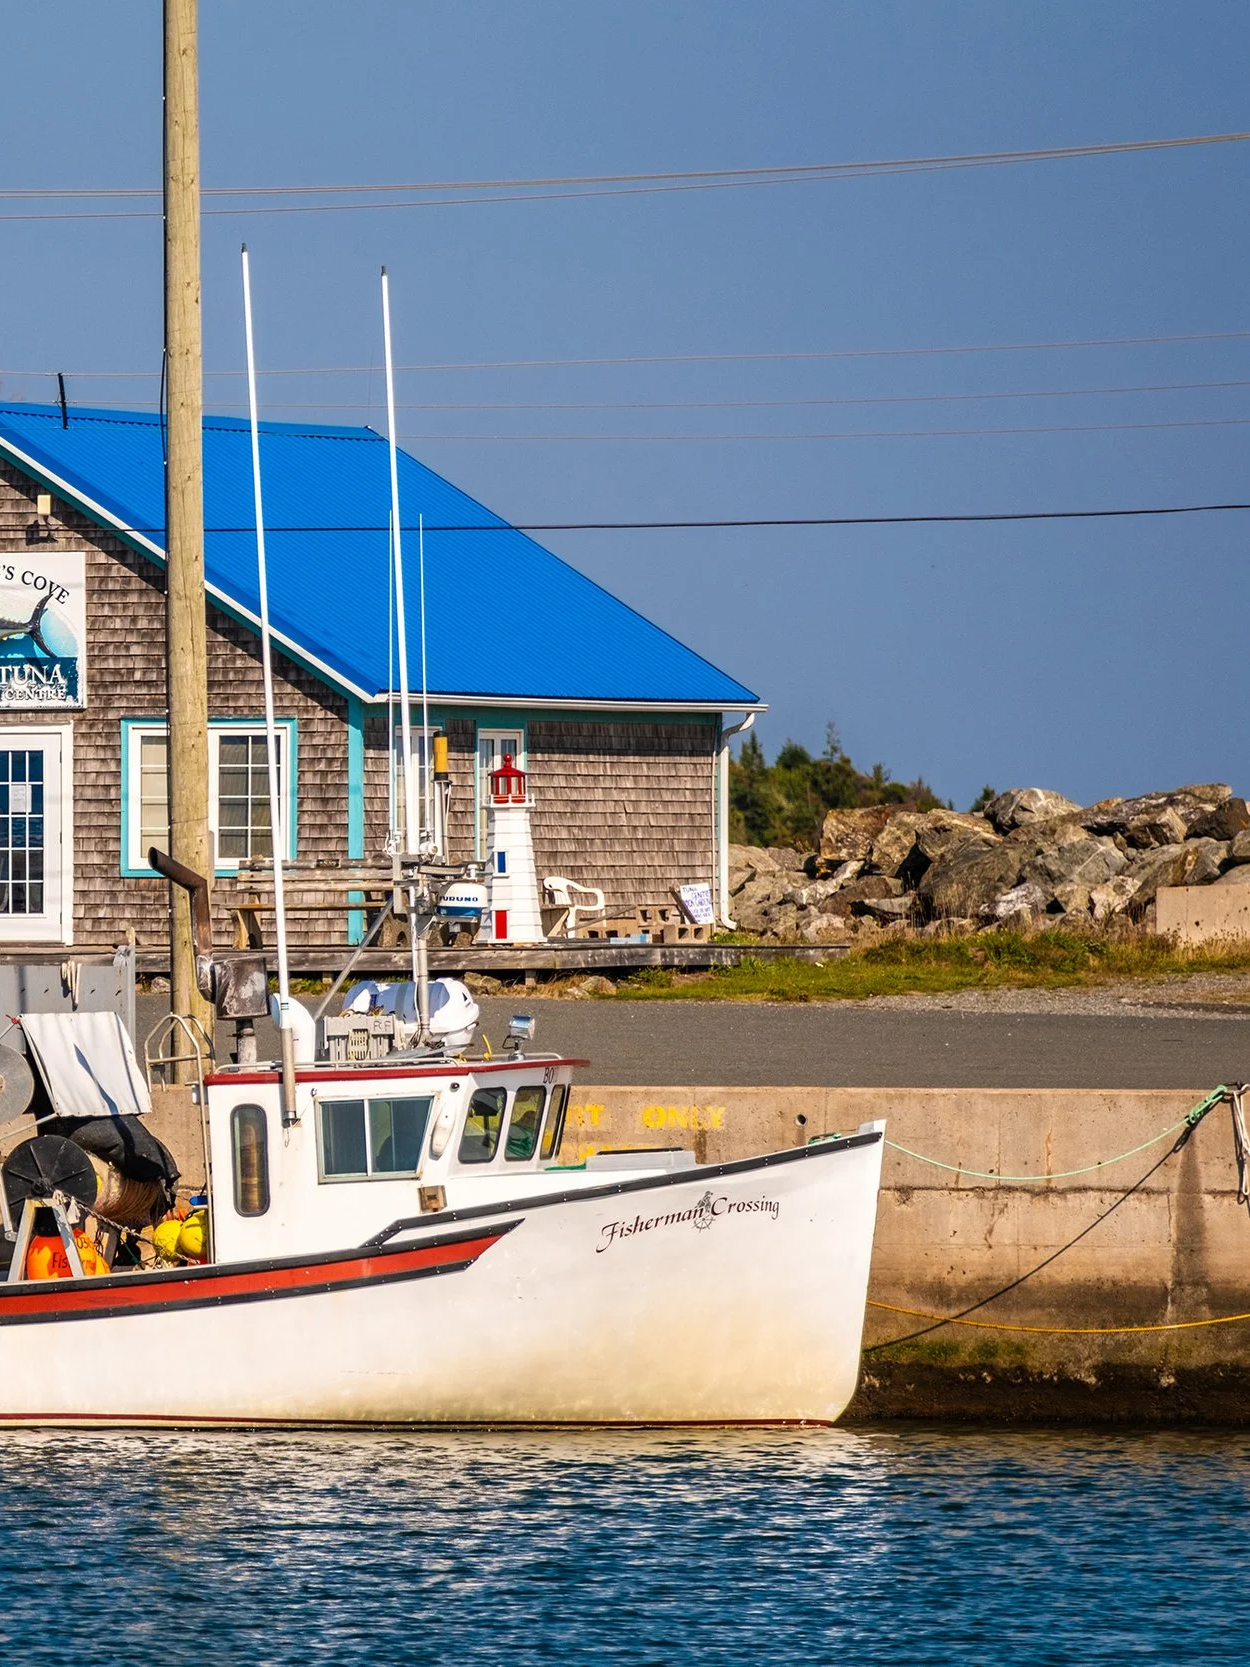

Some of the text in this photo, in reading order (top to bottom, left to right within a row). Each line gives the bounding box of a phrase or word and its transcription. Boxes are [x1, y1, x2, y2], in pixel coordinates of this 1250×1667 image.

[21, 570, 70, 605] COVE
[5, 688, 68, 701] CENTRE
[642, 1105, 726, 1129] ONLY
[596, 1195, 781, 1253] Fisherman Crossing
